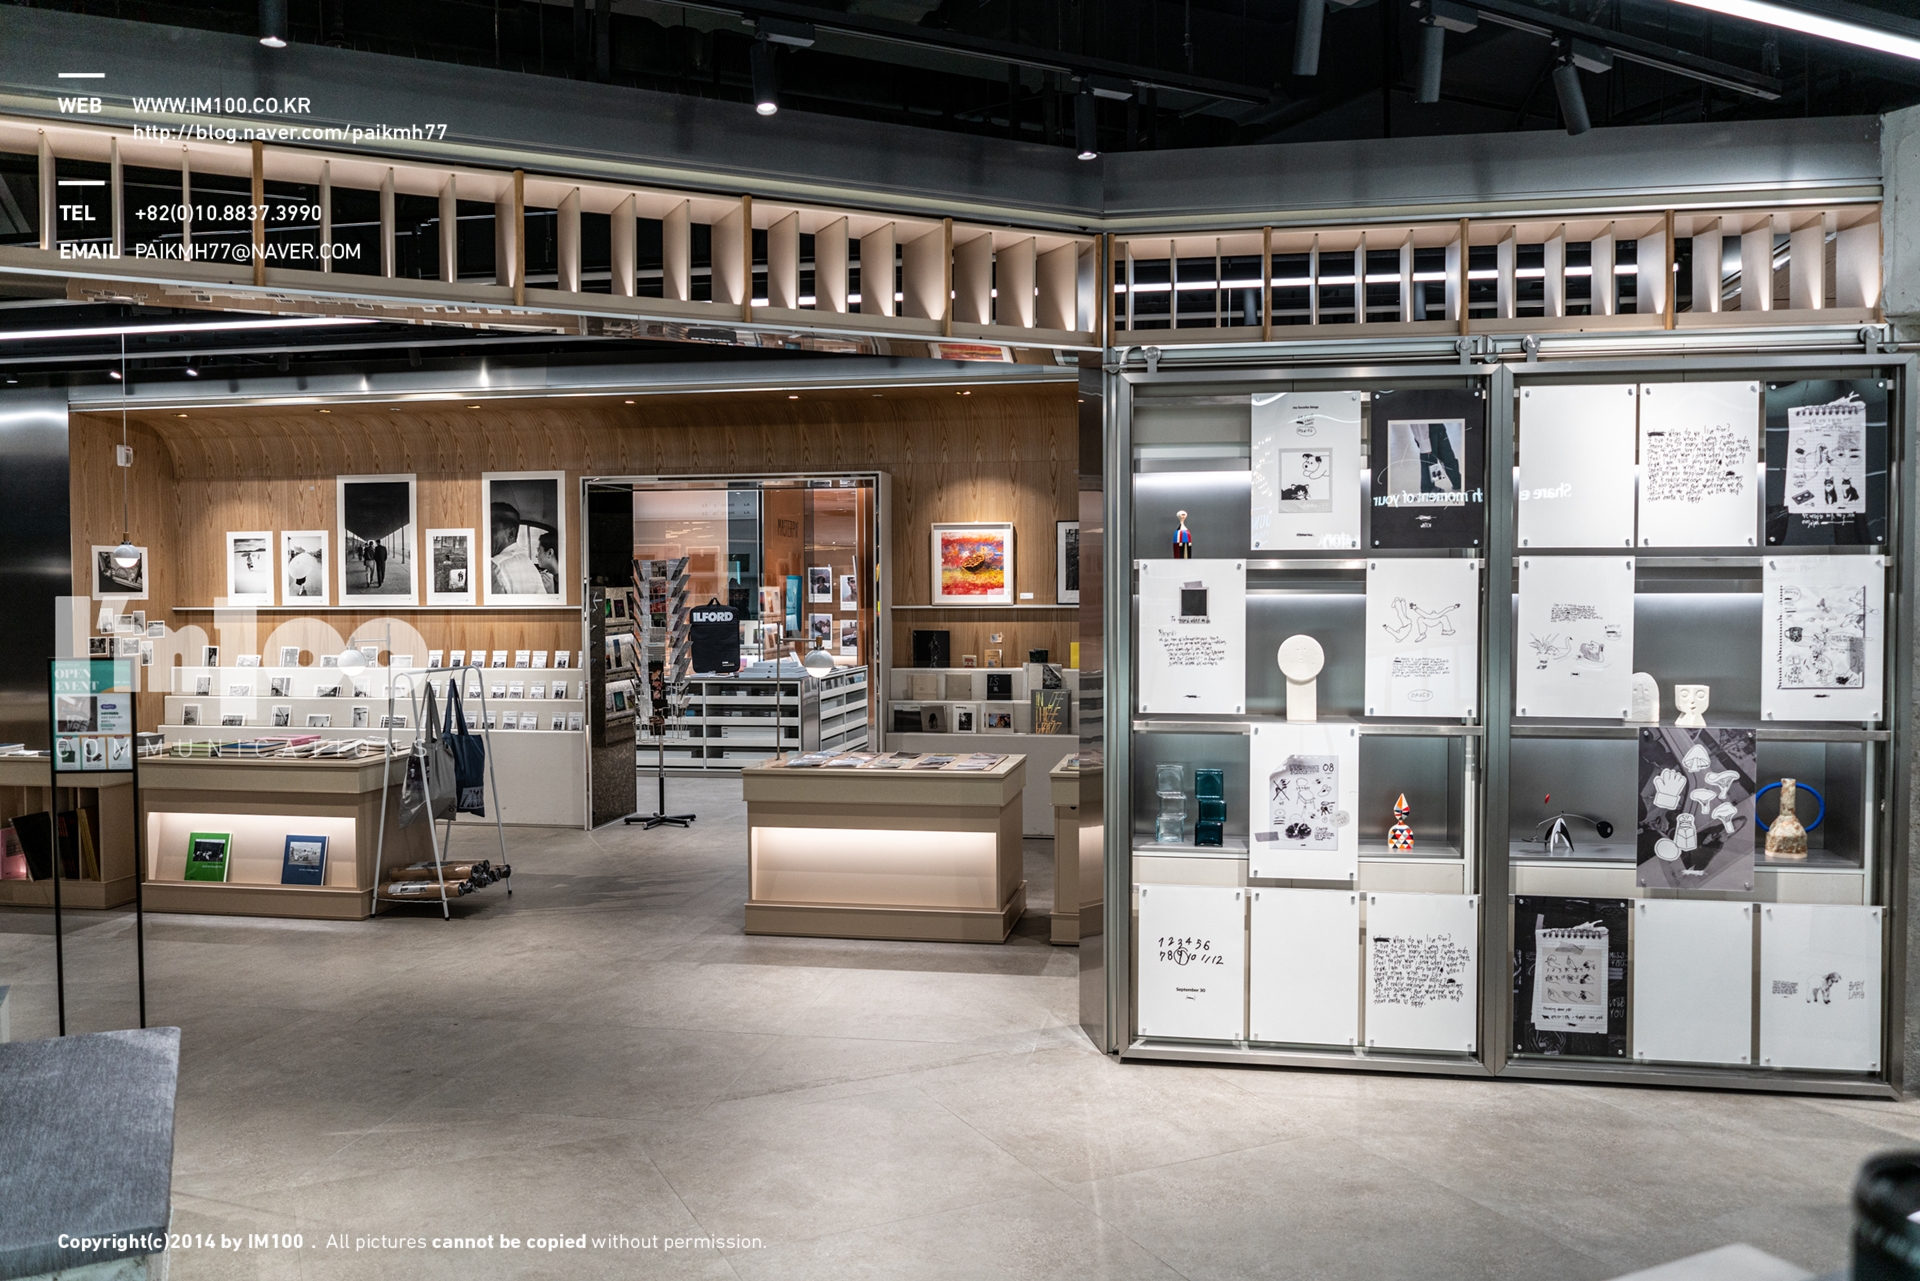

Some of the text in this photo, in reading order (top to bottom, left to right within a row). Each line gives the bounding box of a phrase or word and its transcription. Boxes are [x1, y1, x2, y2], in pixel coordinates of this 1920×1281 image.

[692, 611, 734, 622] ILFORD
[54, 668, 92, 679] OPEN
[55, 681, 100, 691] EVENT
[1322, 763, 1335, 772] 08
[1158, 937, 1164, 947] 1
[1168, 937, 1174, 946] 2
[1185, 937, 1192, 945] 4
[1203, 940, 1210, 951] 6
[1167, 950, 1173, 961] 8
